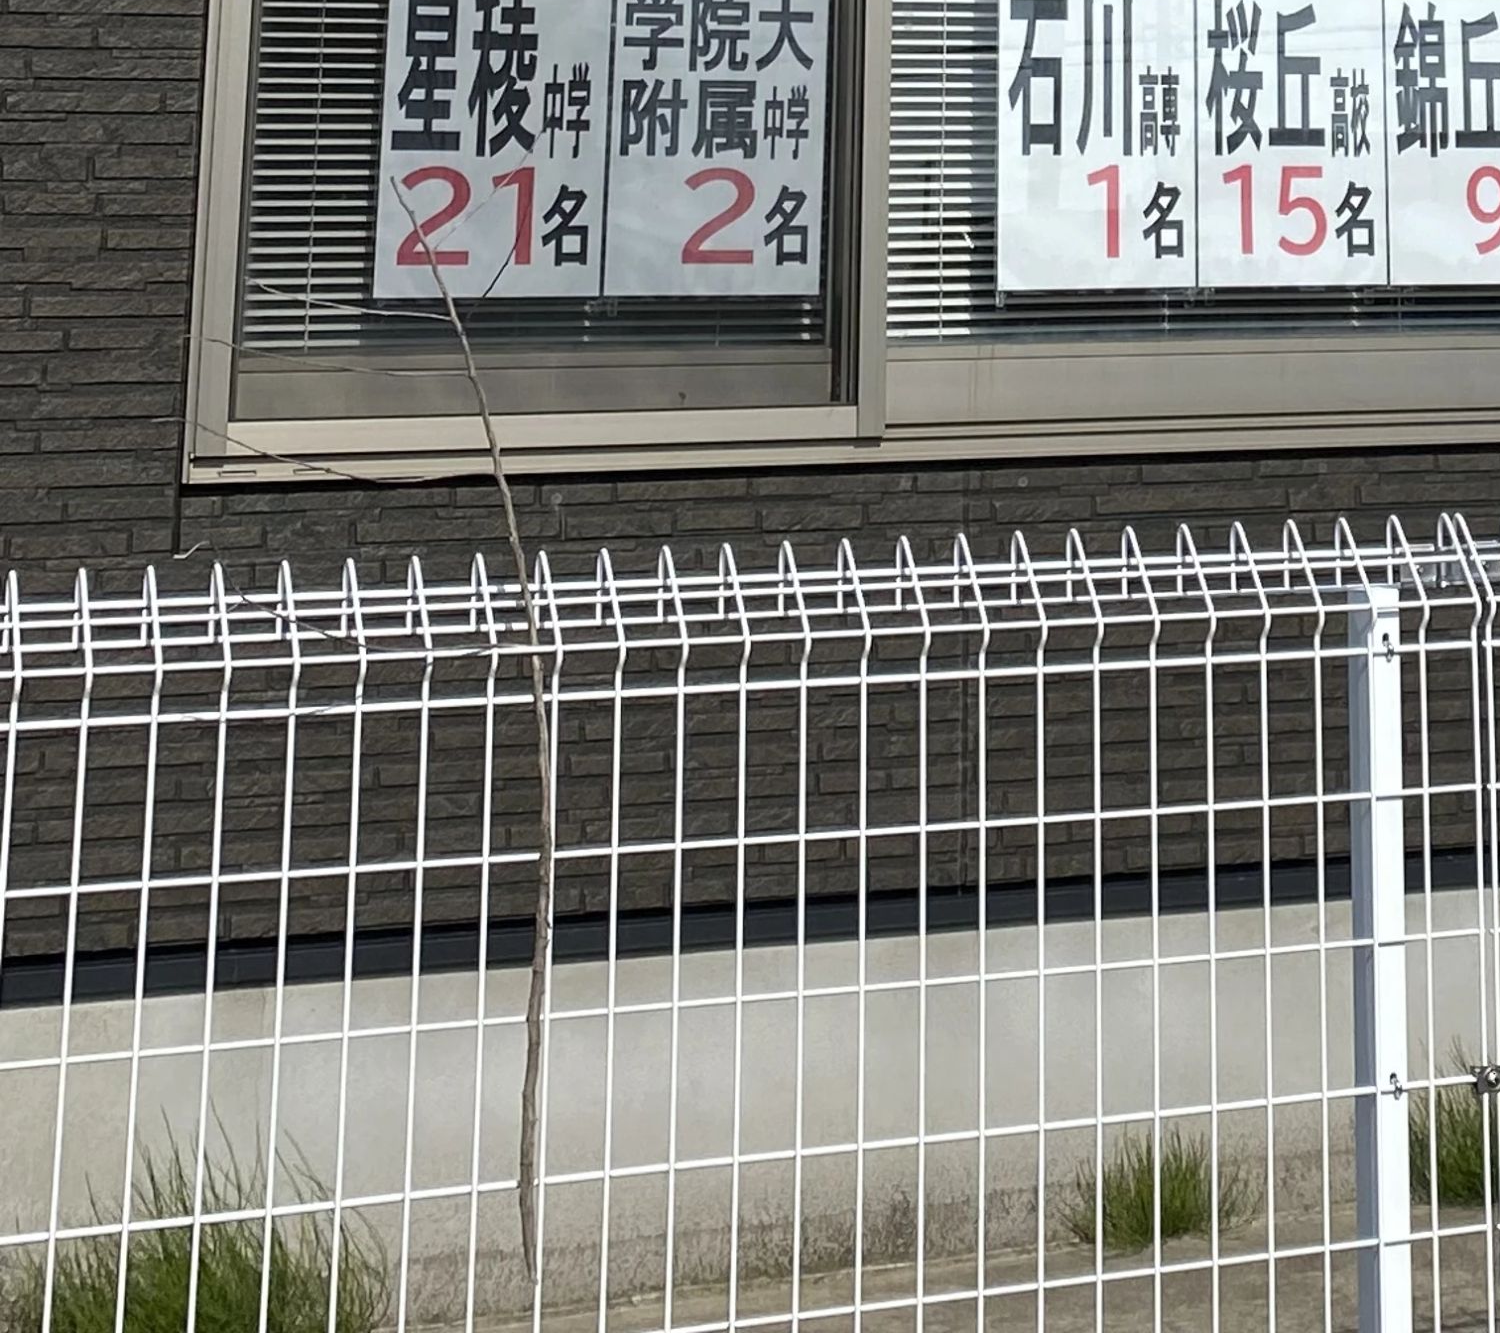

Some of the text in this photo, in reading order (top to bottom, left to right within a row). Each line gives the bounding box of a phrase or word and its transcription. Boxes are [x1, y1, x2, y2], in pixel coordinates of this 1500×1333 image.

[619, 79, 810, 160] 附属中学
[396, 166, 588, 266] 21名
[681, 167, 809, 266] 2名
[1087, 164, 1184, 259] 1名
[1222, 164, 1375, 258] 15名
